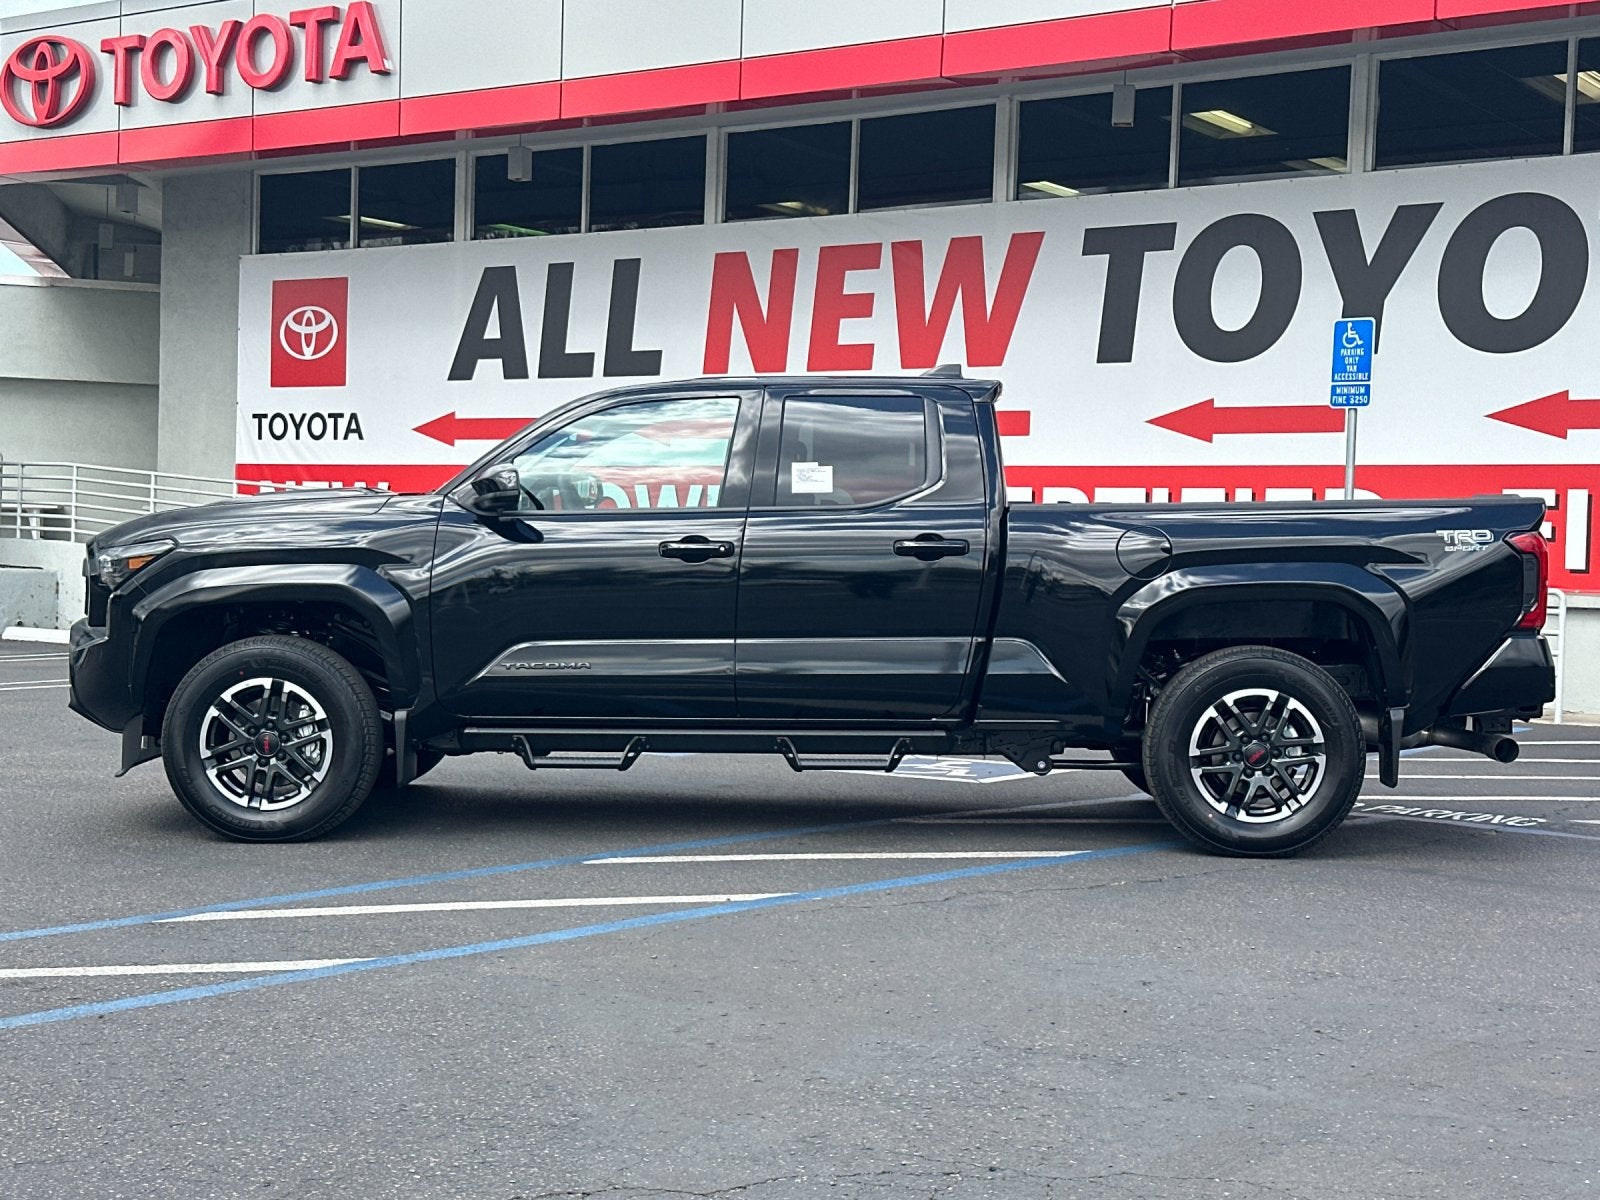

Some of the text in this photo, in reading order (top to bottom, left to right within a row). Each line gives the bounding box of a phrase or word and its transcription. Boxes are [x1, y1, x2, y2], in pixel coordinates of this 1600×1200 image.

[101, 0, 391, 106] TOYOTA
[447, 191, 1590, 381] ALL NEW TOYO
[1340, 348, 1365, 356] PARKING
[1344, 356, 1359, 364] ONLY
[1333, 372, 1369, 381] ACCESSIBLE
[1336, 386, 1365, 395] MINIMUM
[1332, 395, 1347, 404] FINE
[251, 412, 365, 442] TOYOTA
[1435, 529, 1494, 545] TRD
[1444, 544, 1489, 552] SPORT
[501, 661, 592, 671] TACOMA
[1361, 804, 1547, 827] PARKING
